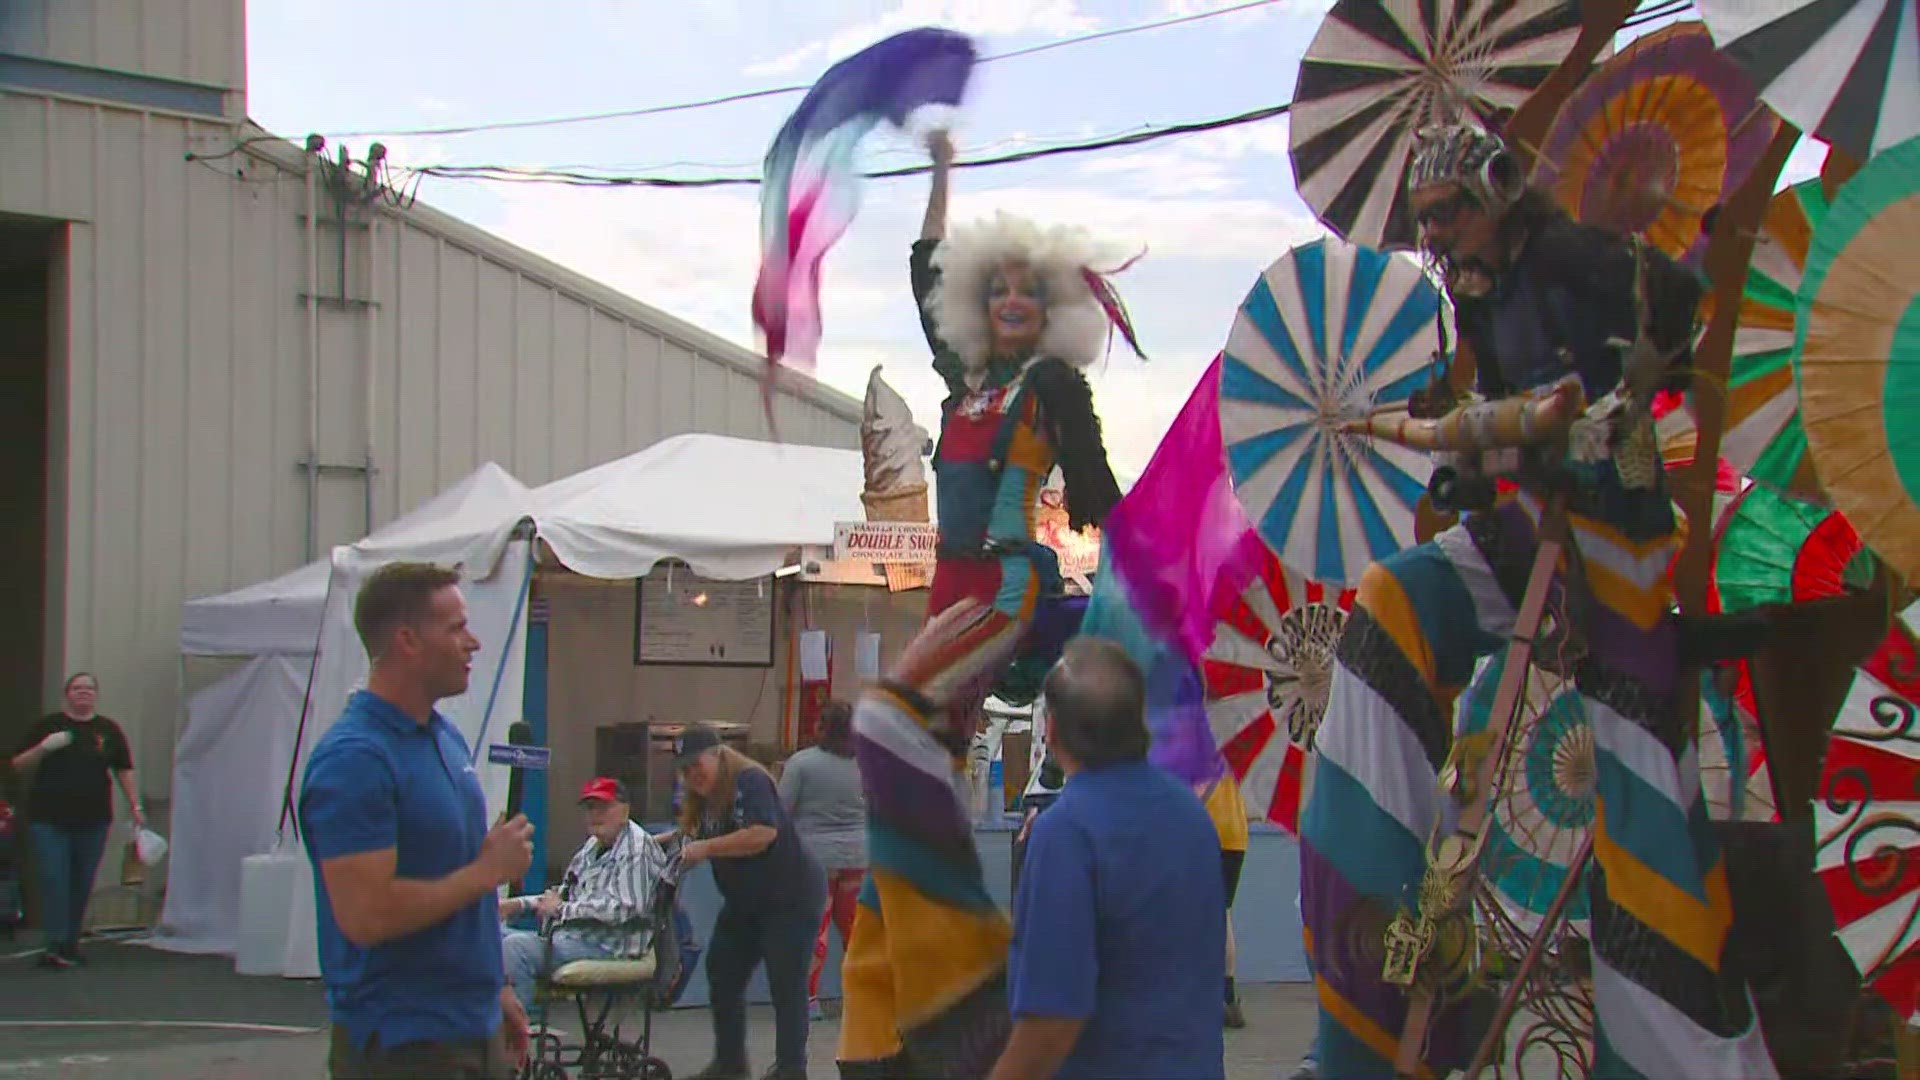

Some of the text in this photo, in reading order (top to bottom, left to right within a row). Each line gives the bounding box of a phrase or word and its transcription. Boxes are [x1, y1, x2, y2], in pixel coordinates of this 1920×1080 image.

[897, 525, 936, 534] CHOCOLA
[848, 533, 937, 549] DOUBLE SWI
